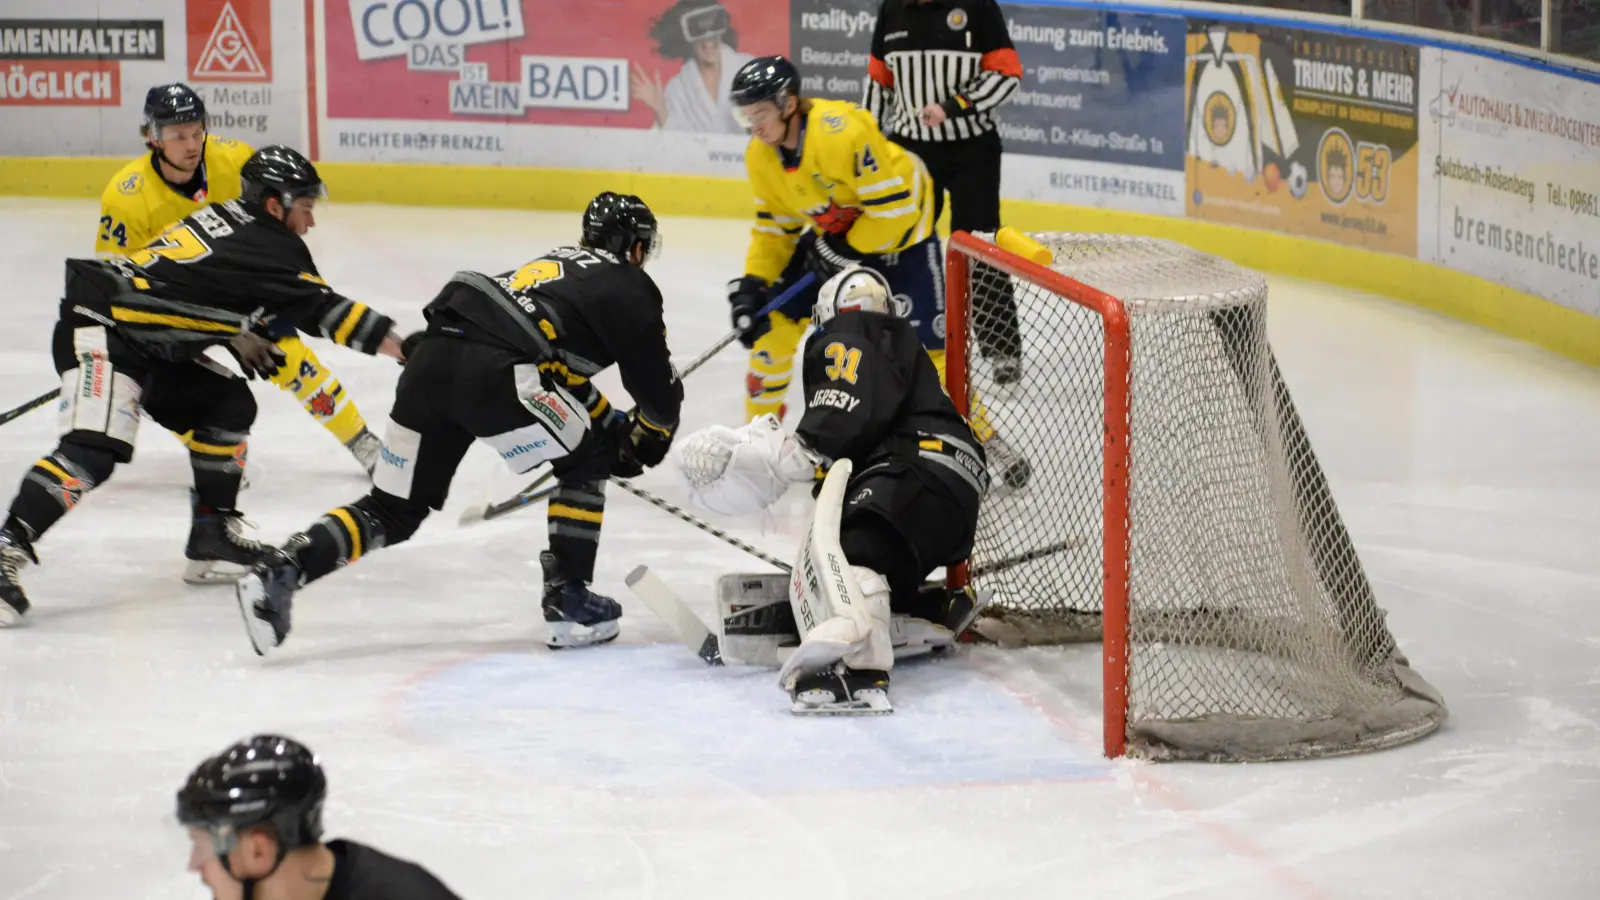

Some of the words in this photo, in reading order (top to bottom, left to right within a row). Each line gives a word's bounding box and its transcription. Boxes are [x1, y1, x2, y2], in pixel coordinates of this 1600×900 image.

[361, 0, 512, 47] COOL!
[1008, 18, 1066, 51] lanung
[1069, 28, 1104, 47] zum
[1107, 26, 1169, 55] Erlebnis.
[0, 28, 157, 54] MENHALTEN
[412, 43, 461, 67] DAS
[462, 66, 485, 80] IST
[528, 64, 621, 103] BAD!
[801, 75, 824, 91] mit
[827, 75, 859, 93] dem
[1037, 65, 1110, 84] gemeinsam
[1293, 58, 1354, 95] TRIKOTS
[1356, 68, 1369, 97] &
[1372, 69, 1414, 104] MEHR
[213, 87, 272, 105] Metall
[453, 85, 520, 110] MEIN
[1458, 94, 1512, 124] AUTOHAUS
[853, 143, 880, 178] 14
[100, 214, 128, 248] 34
[824, 342, 863, 386] 31
